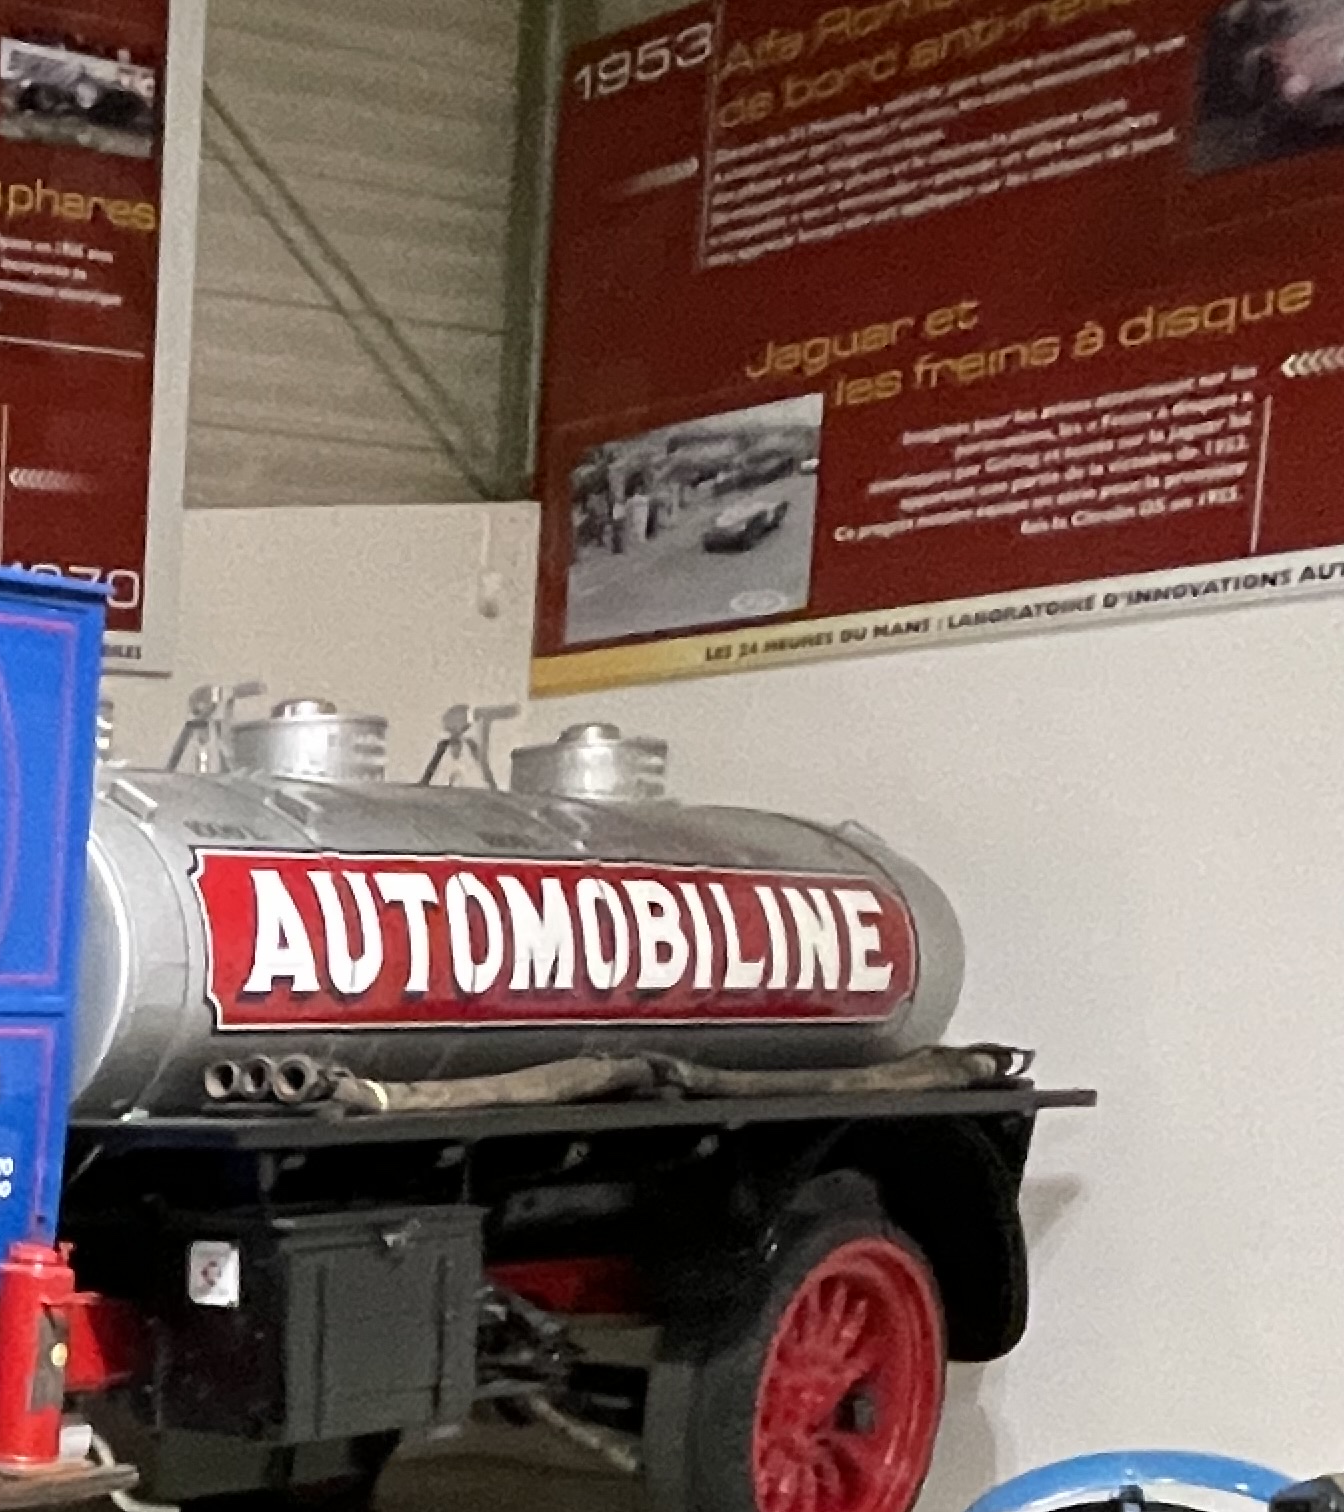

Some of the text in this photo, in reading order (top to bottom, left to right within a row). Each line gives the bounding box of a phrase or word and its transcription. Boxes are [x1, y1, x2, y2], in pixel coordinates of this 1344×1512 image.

[571, 21, 714, 101] 1953
[783, 48, 899, 110] bord
[8, 178, 156, 232] phares
[744, 299, 982, 380] Jaguar et
[831, 280, 1316, 408] les freins à disque
[839, 627, 868, 644] DU
[243, 867, 895, 996] AUTOMOBILINE
